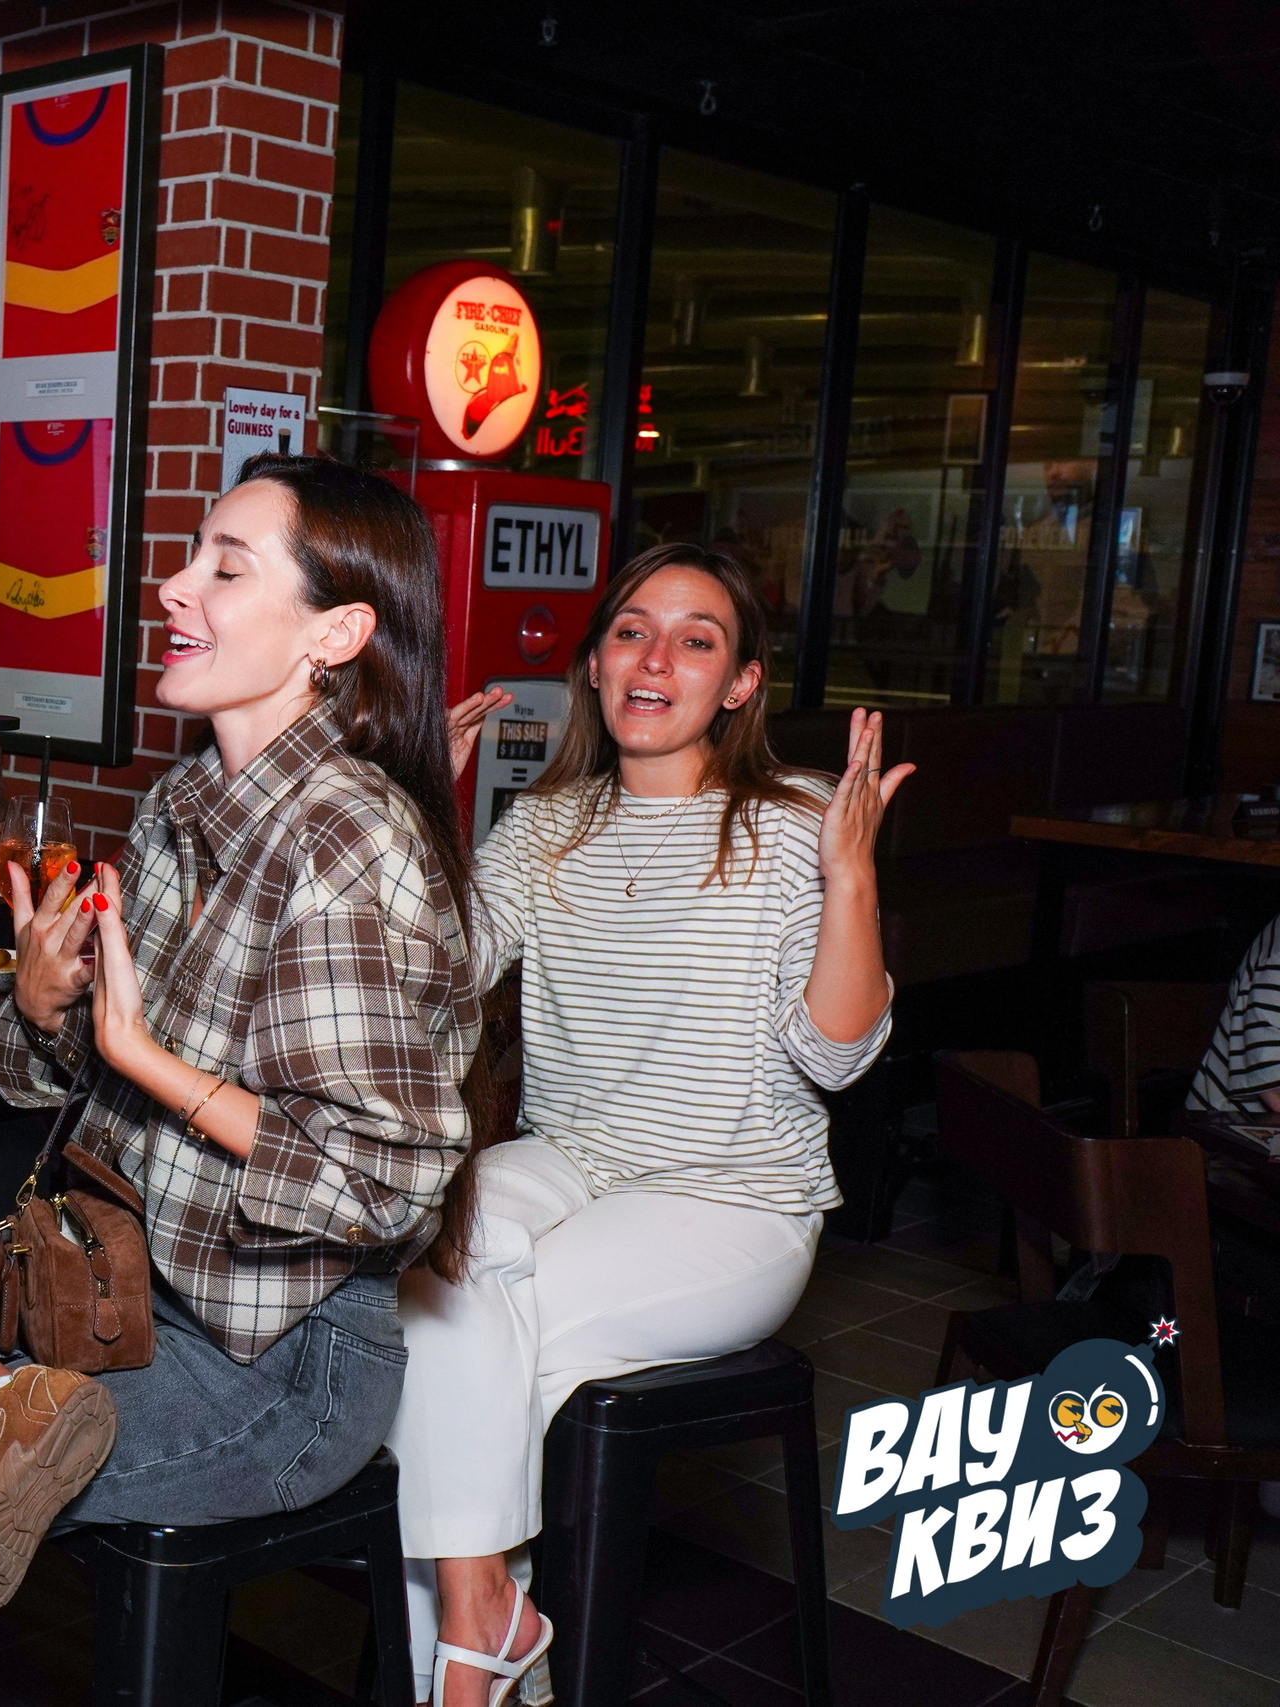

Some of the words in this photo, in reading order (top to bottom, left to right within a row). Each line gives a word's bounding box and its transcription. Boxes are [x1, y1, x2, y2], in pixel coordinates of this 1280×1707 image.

[474, 322, 509, 335] GASOLINE
[228, 400, 258, 418] Lovely
[260, 403, 277, 420] day
[279, 405, 292, 419] for
[294, 410, 300, 420] a
[227, 418, 273, 437] GUINNESS
[491, 517, 588, 577] ETHYL
[514, 703, 535, 718] Wayne
[502, 722, 522, 741] THIS
[524, 723, 545, 742] SALE
